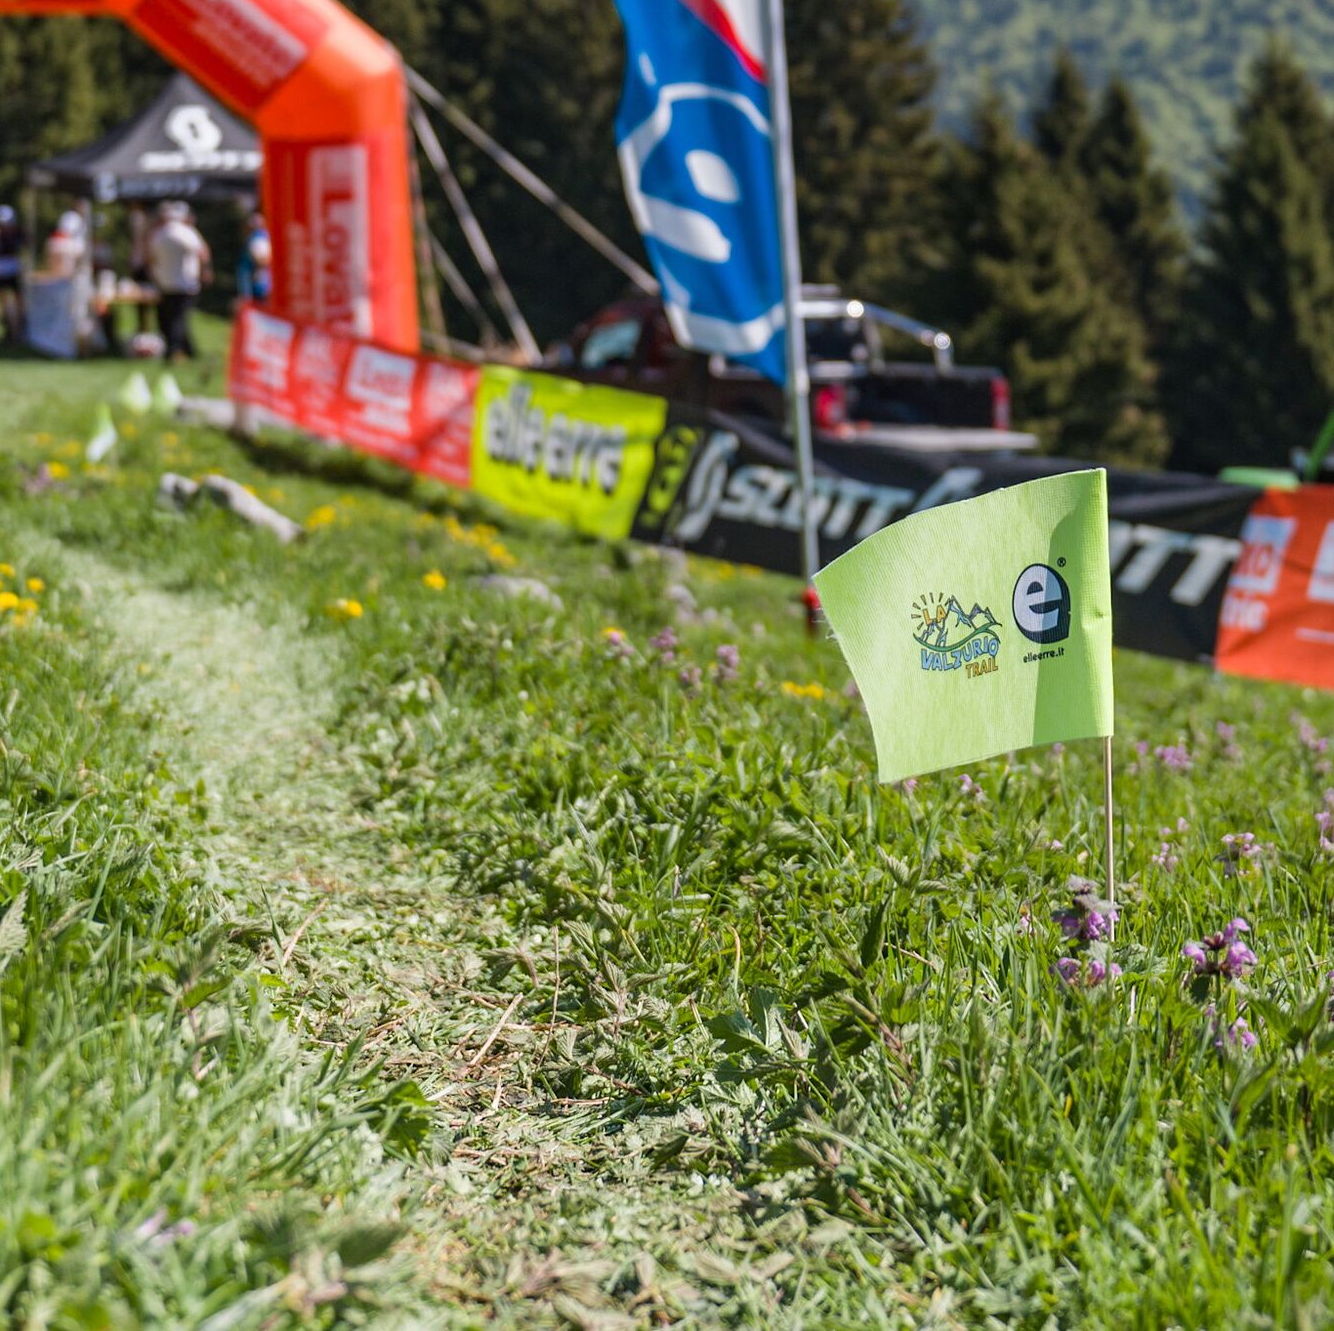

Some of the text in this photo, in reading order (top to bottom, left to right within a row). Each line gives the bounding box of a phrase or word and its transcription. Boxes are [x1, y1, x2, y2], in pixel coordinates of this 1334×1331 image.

[923, 604, 946, 626] LA
[920, 635, 1000, 672] VALZURIO
[1023, 647, 1065, 663] elleerre.it
[965, 656, 999, 679] TRAIL
